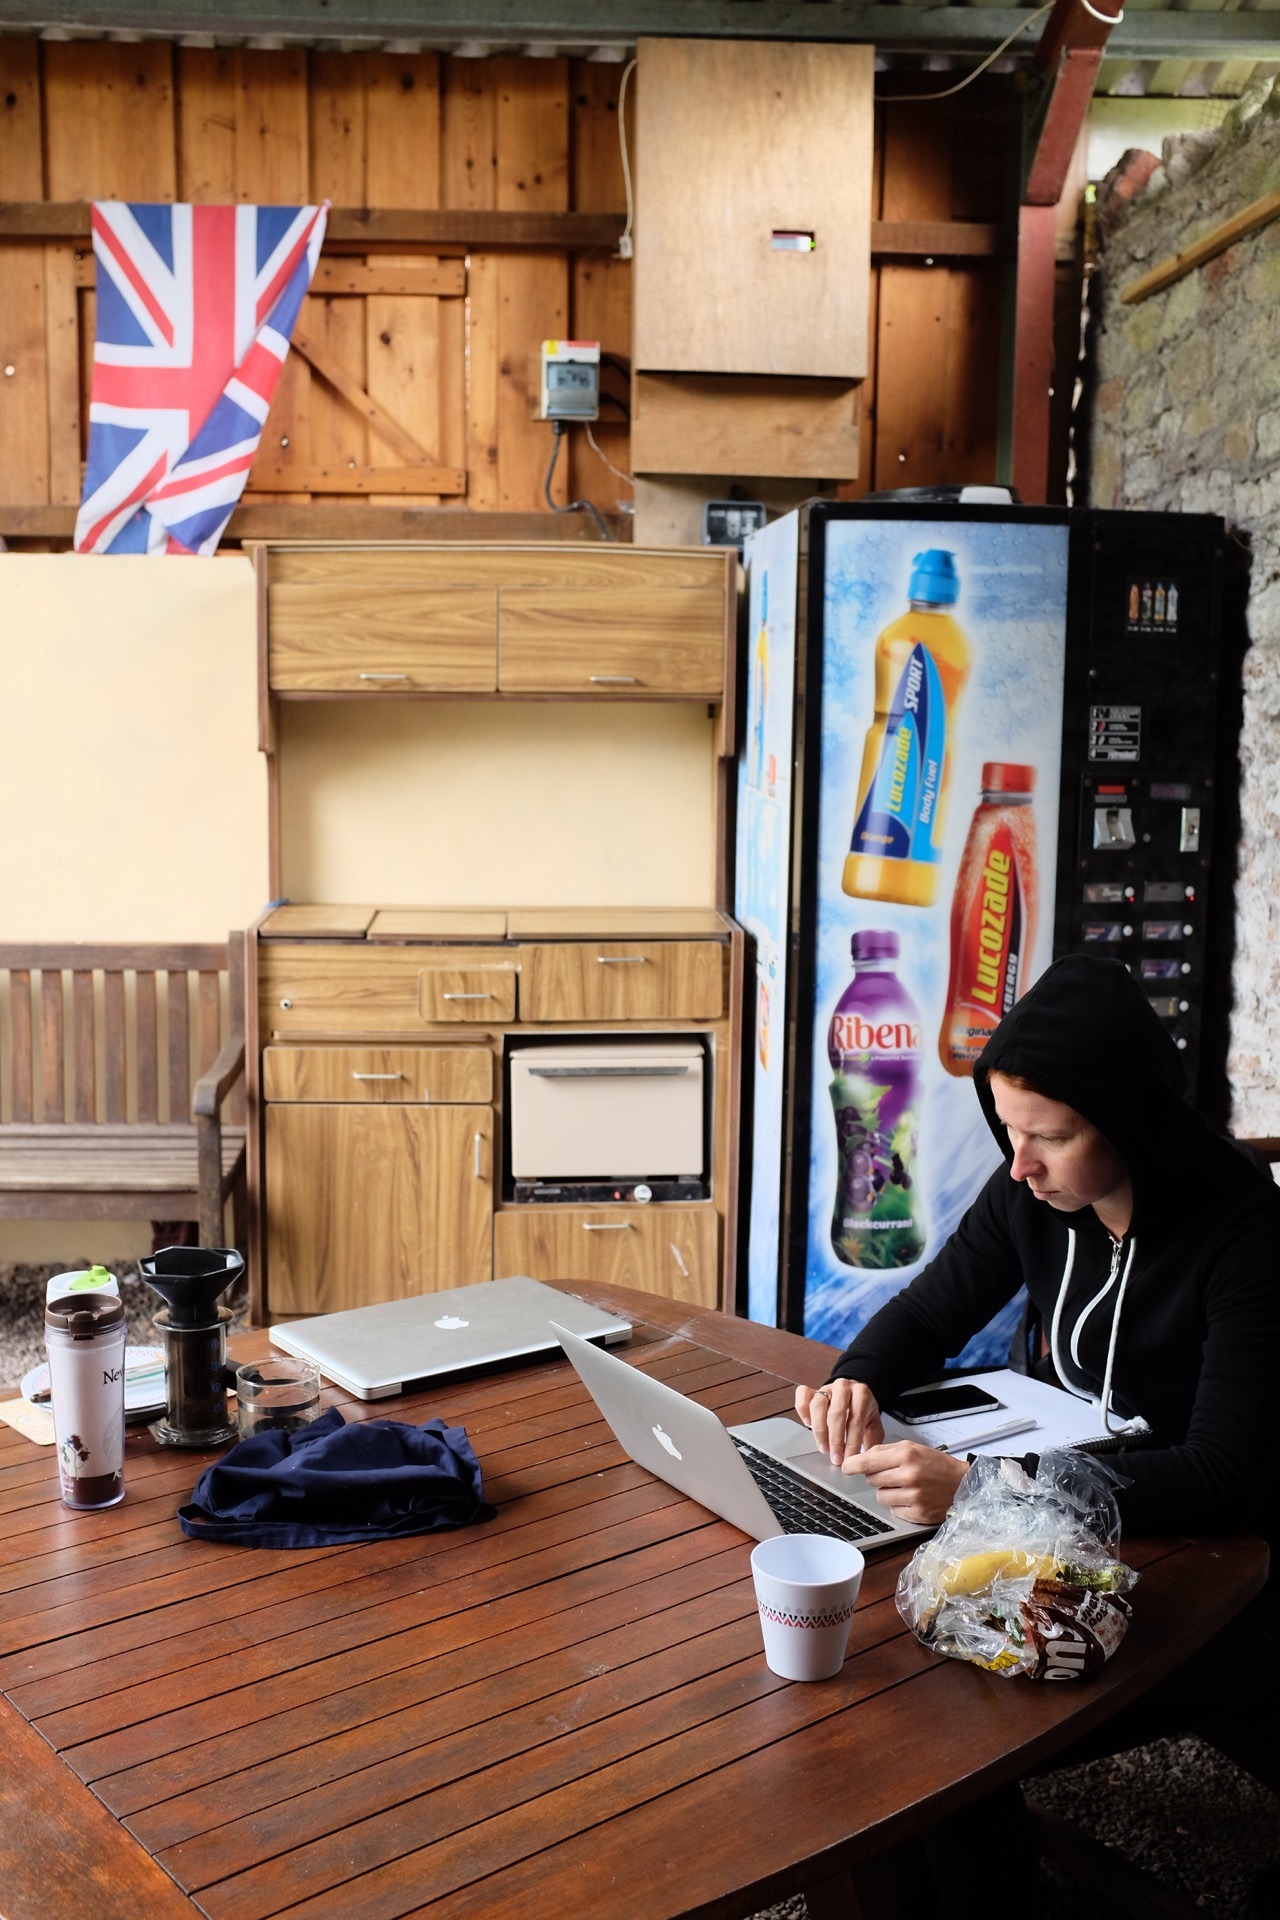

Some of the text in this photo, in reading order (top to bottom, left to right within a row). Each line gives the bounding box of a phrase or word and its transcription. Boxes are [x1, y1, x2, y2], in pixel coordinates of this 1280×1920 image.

[903, 654, 924, 714] SPORT
[886, 726, 913, 814] Lucozade
[919, 759, 939, 824] Body Fuel
[971, 849, 1011, 1005] Lucozade
[1003, 952, 1018, 1013] ENERGY
[830, 1015, 923, 1051] Ribena
[843, 1217, 914, 1230] Blackcurrant
